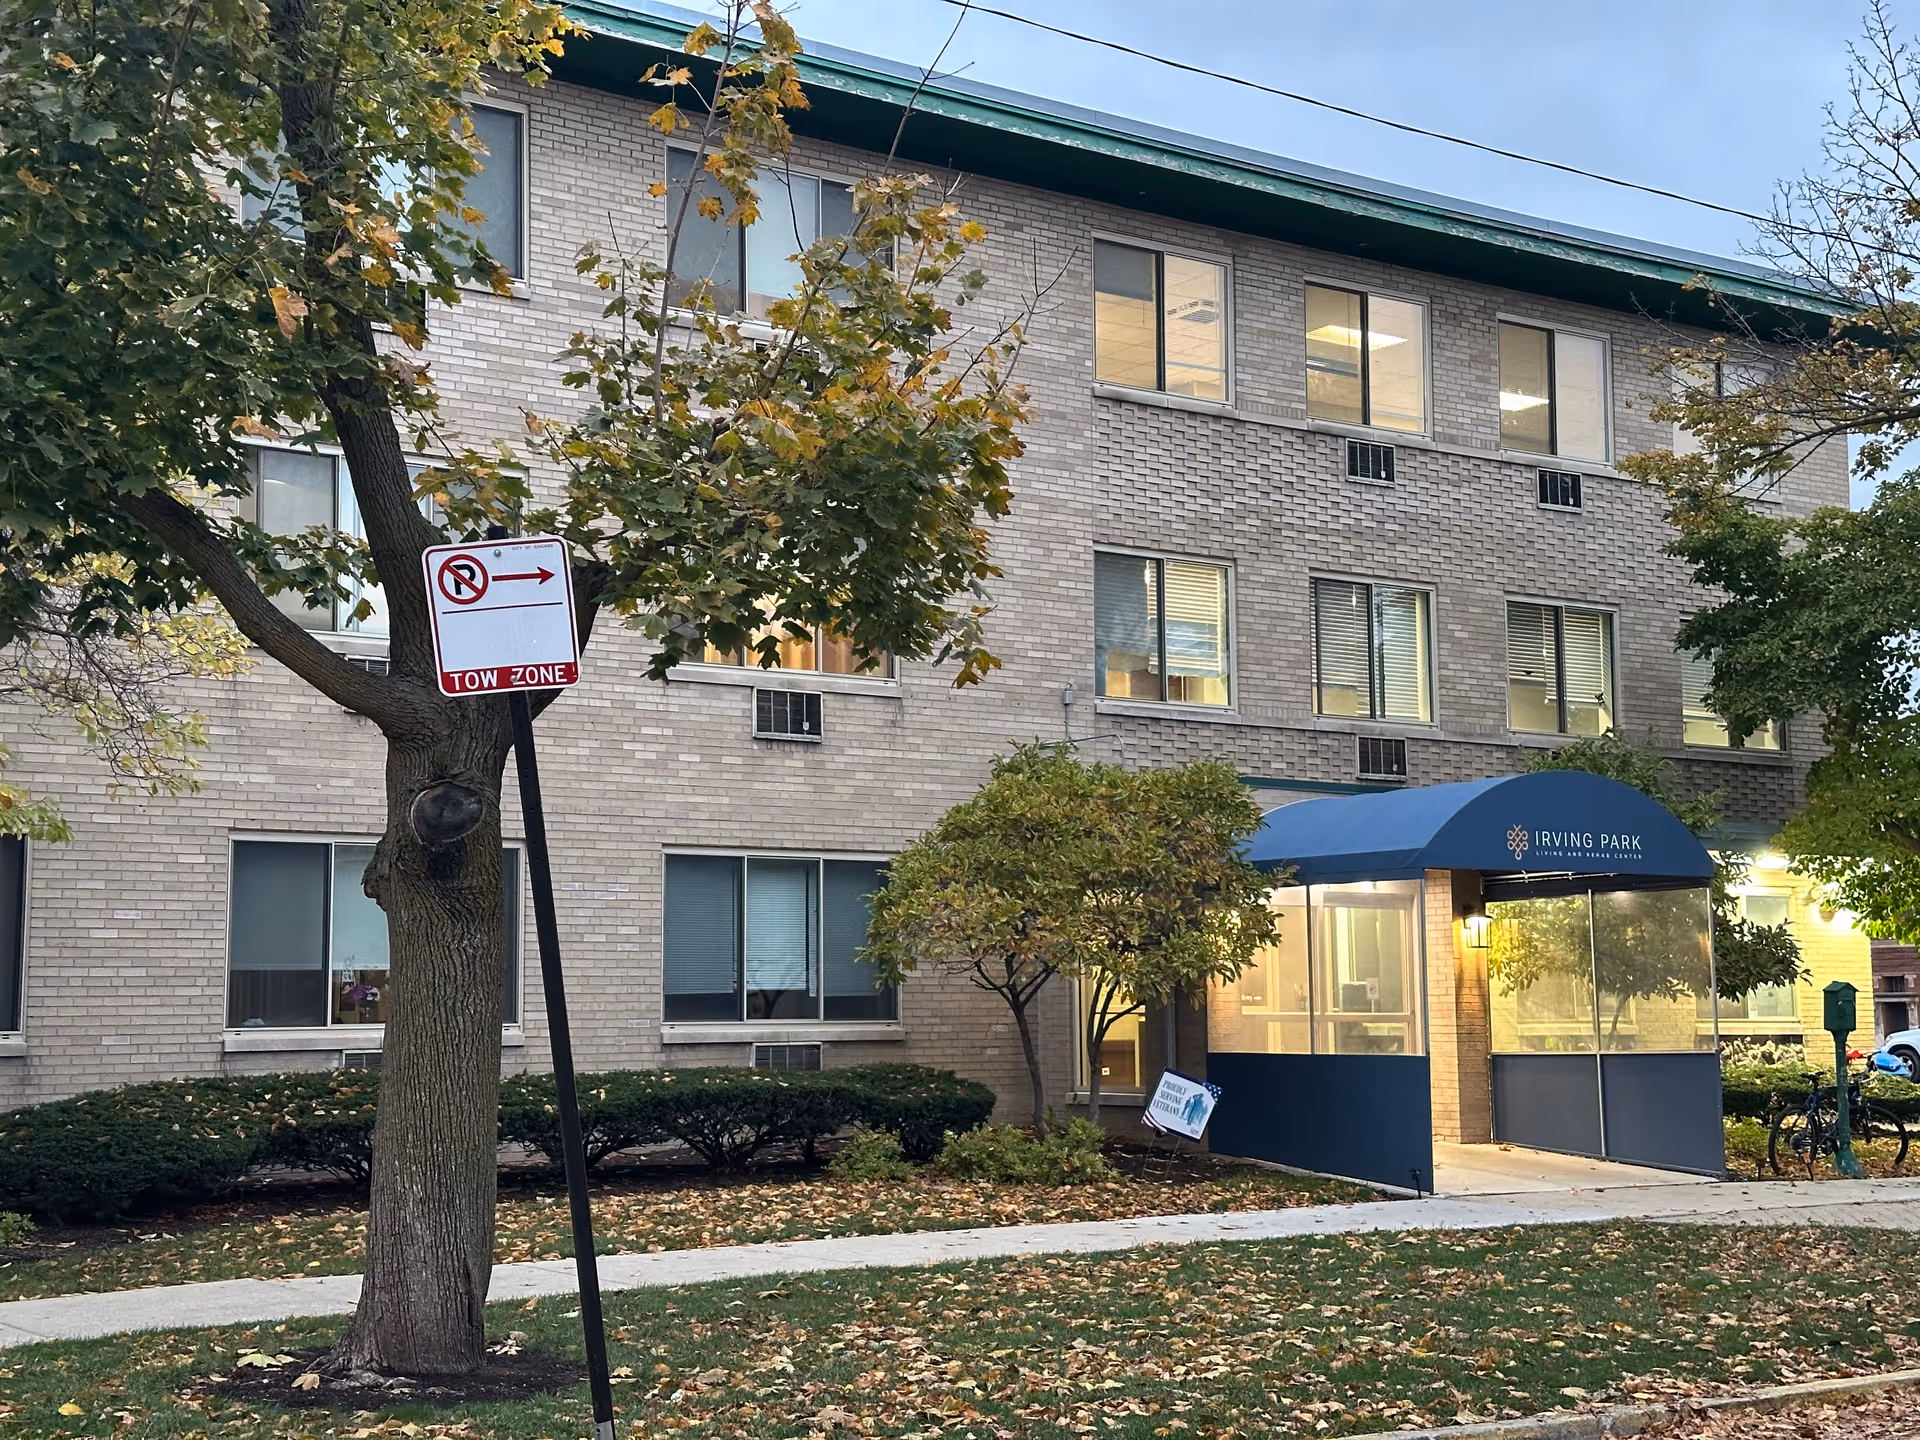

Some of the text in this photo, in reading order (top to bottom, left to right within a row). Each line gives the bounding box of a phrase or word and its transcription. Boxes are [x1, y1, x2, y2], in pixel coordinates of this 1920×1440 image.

[449, 665, 568, 691] TOW ZONE
[1534, 830, 1642, 851] IRVING PARK
[1162, 1080, 1187, 1096] PROUDLY
[1152, 1098, 1181, 1116] VETERANS
[1159, 1090, 1183, 1106] SERVING
